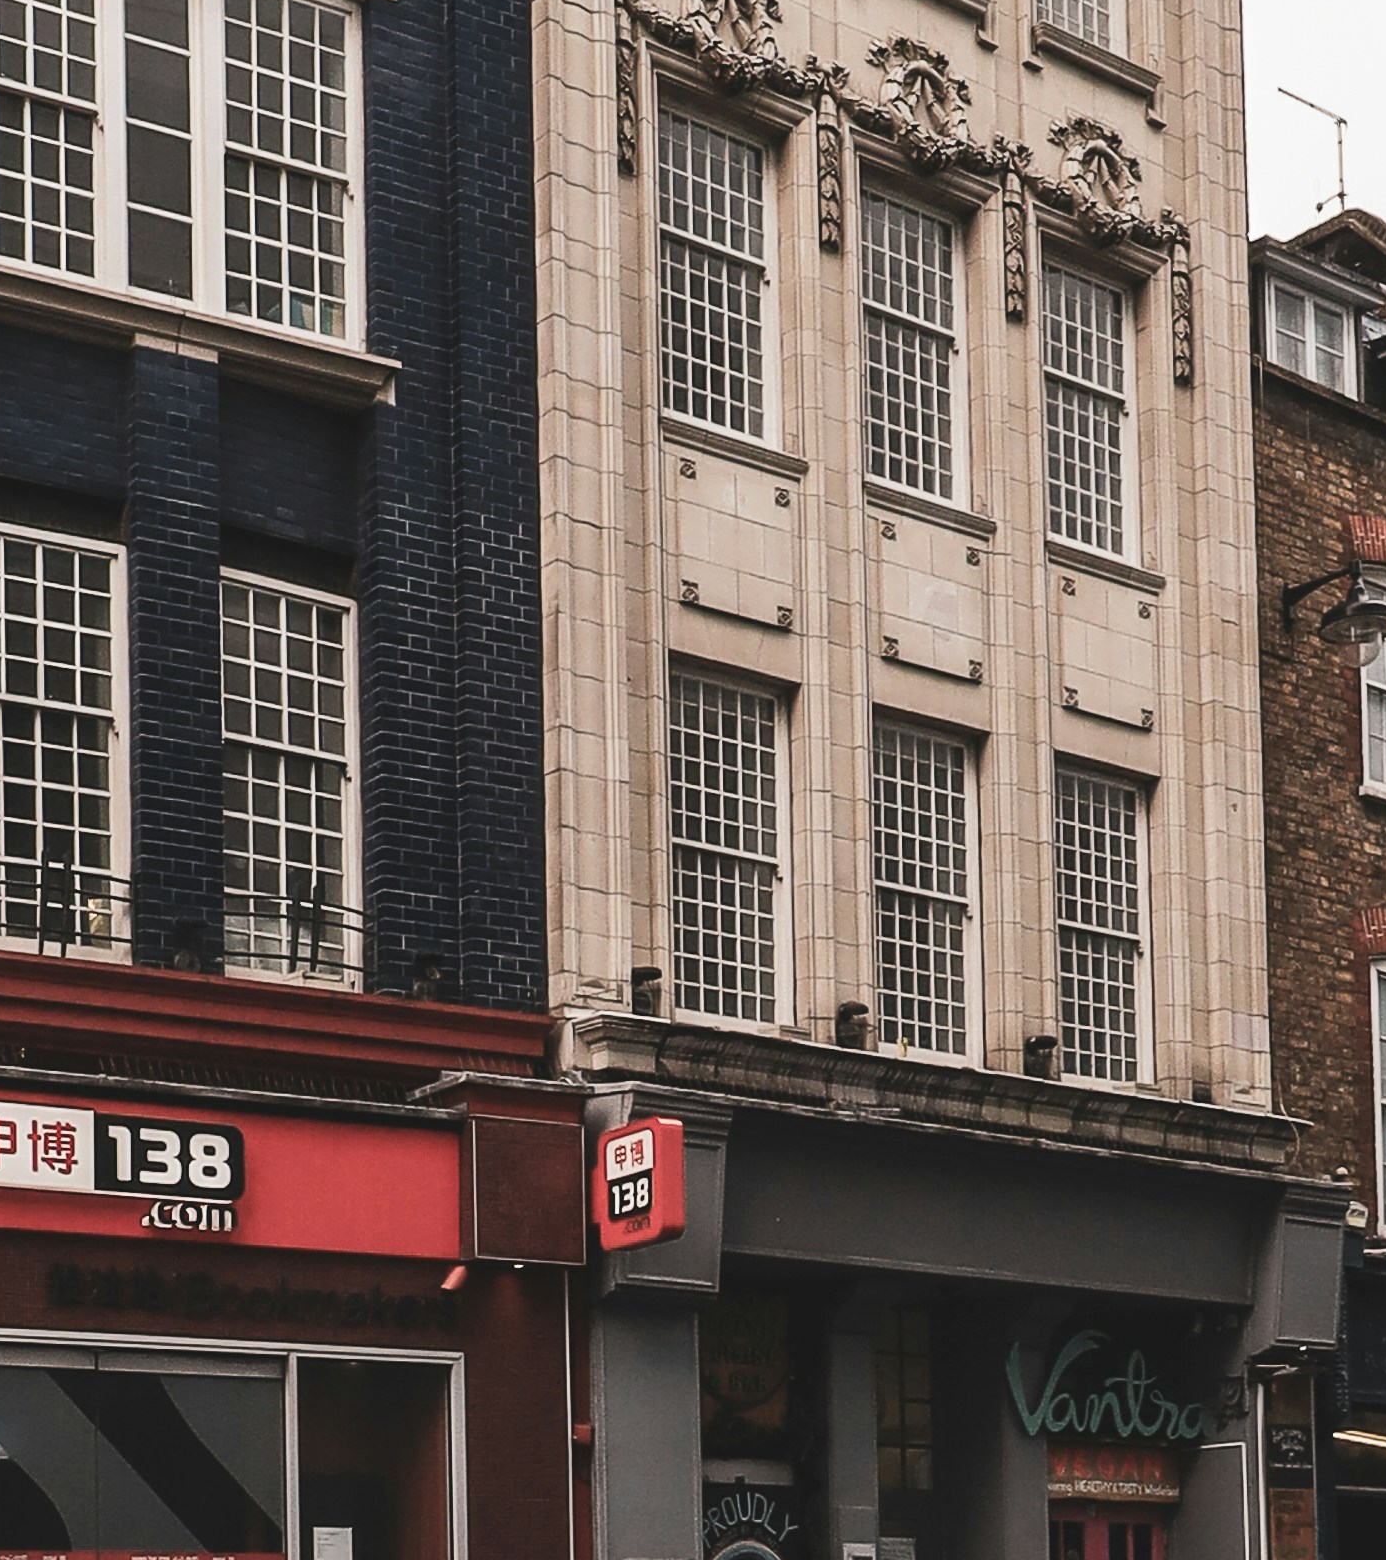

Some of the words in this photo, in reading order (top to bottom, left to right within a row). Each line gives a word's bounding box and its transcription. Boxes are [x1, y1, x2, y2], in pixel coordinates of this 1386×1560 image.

[107, 1124, 232, 1189] 138
[611, 1177, 649, 1215] 138
[141, 1200, 237, 1233] .com
[1006, 1329, 1207, 1440] Vantra
[1048, 1448, 1163, 1481] VEGAN
